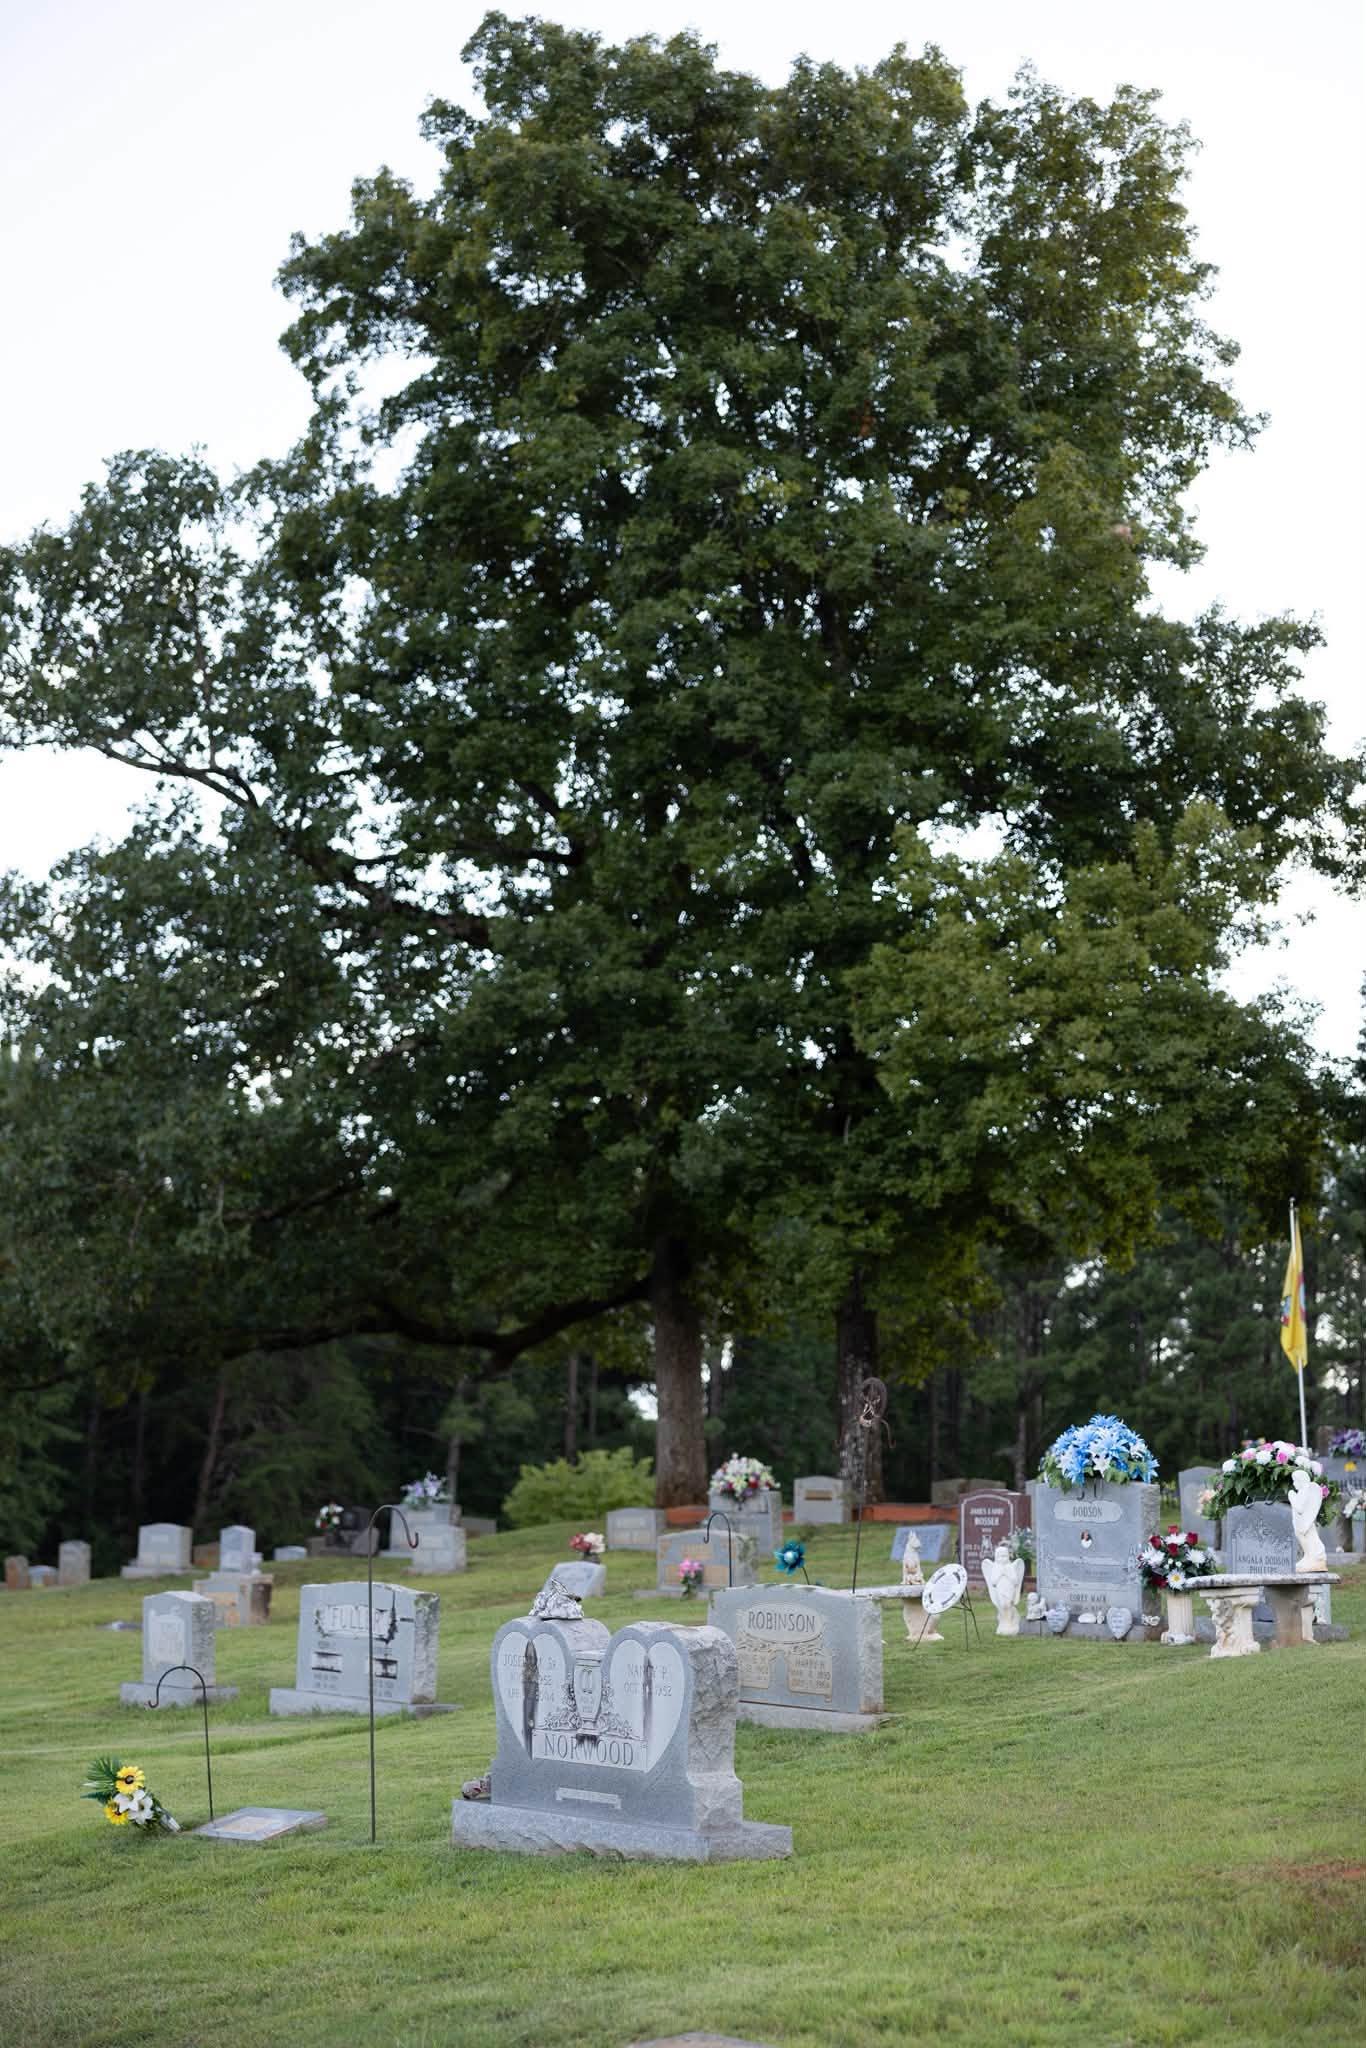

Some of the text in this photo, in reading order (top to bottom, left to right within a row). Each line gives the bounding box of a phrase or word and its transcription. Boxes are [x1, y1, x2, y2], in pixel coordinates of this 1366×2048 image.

[1072, 1505, 1103, 1519] DODSON
[1264, 1555, 1291, 1567] DODSON
[748, 1611, 815, 1633] ROBINSON
[543, 1731, 635, 1767] NORWOOD
